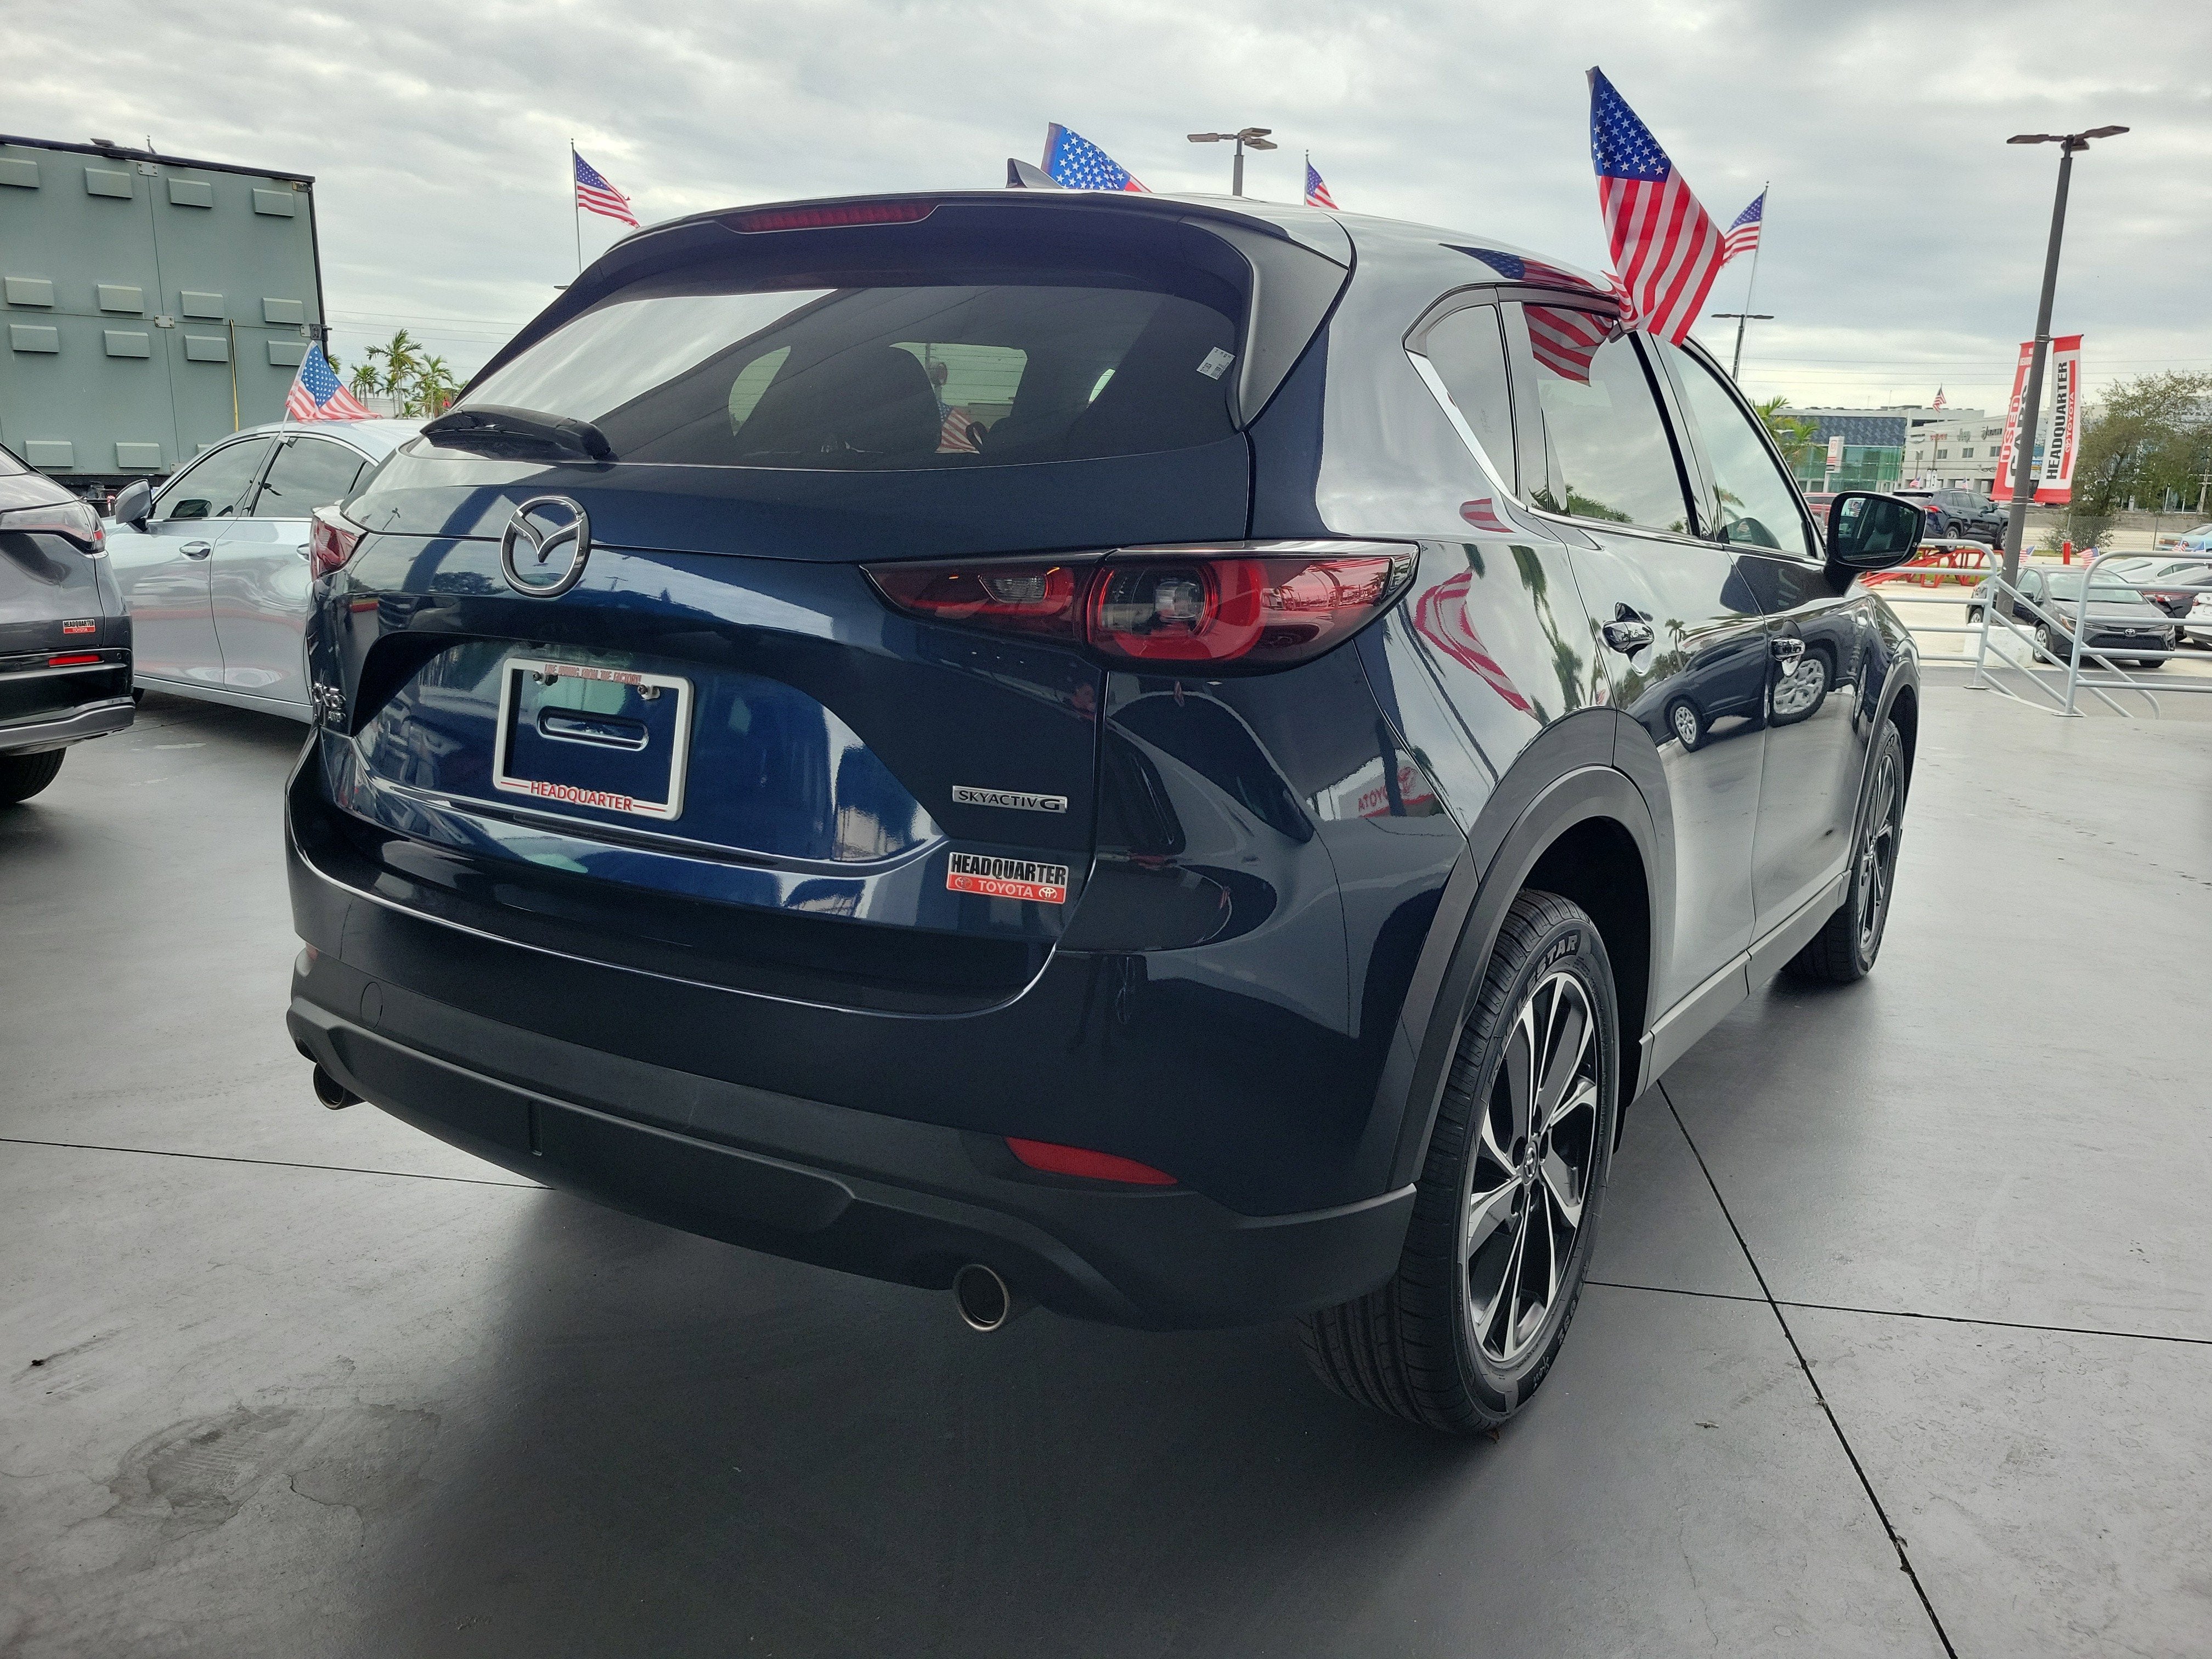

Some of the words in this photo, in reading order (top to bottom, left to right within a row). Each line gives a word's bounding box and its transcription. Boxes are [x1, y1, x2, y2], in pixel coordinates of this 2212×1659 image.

[2000, 395, 2021, 462] USED
[2046, 361, 2067, 479] HEADQUARTER
[531, 781, 633, 811] HEADQUARTER
[951, 854, 1066, 885] HEADQUARTER
[978, 880, 1034, 898] TOYOTA
